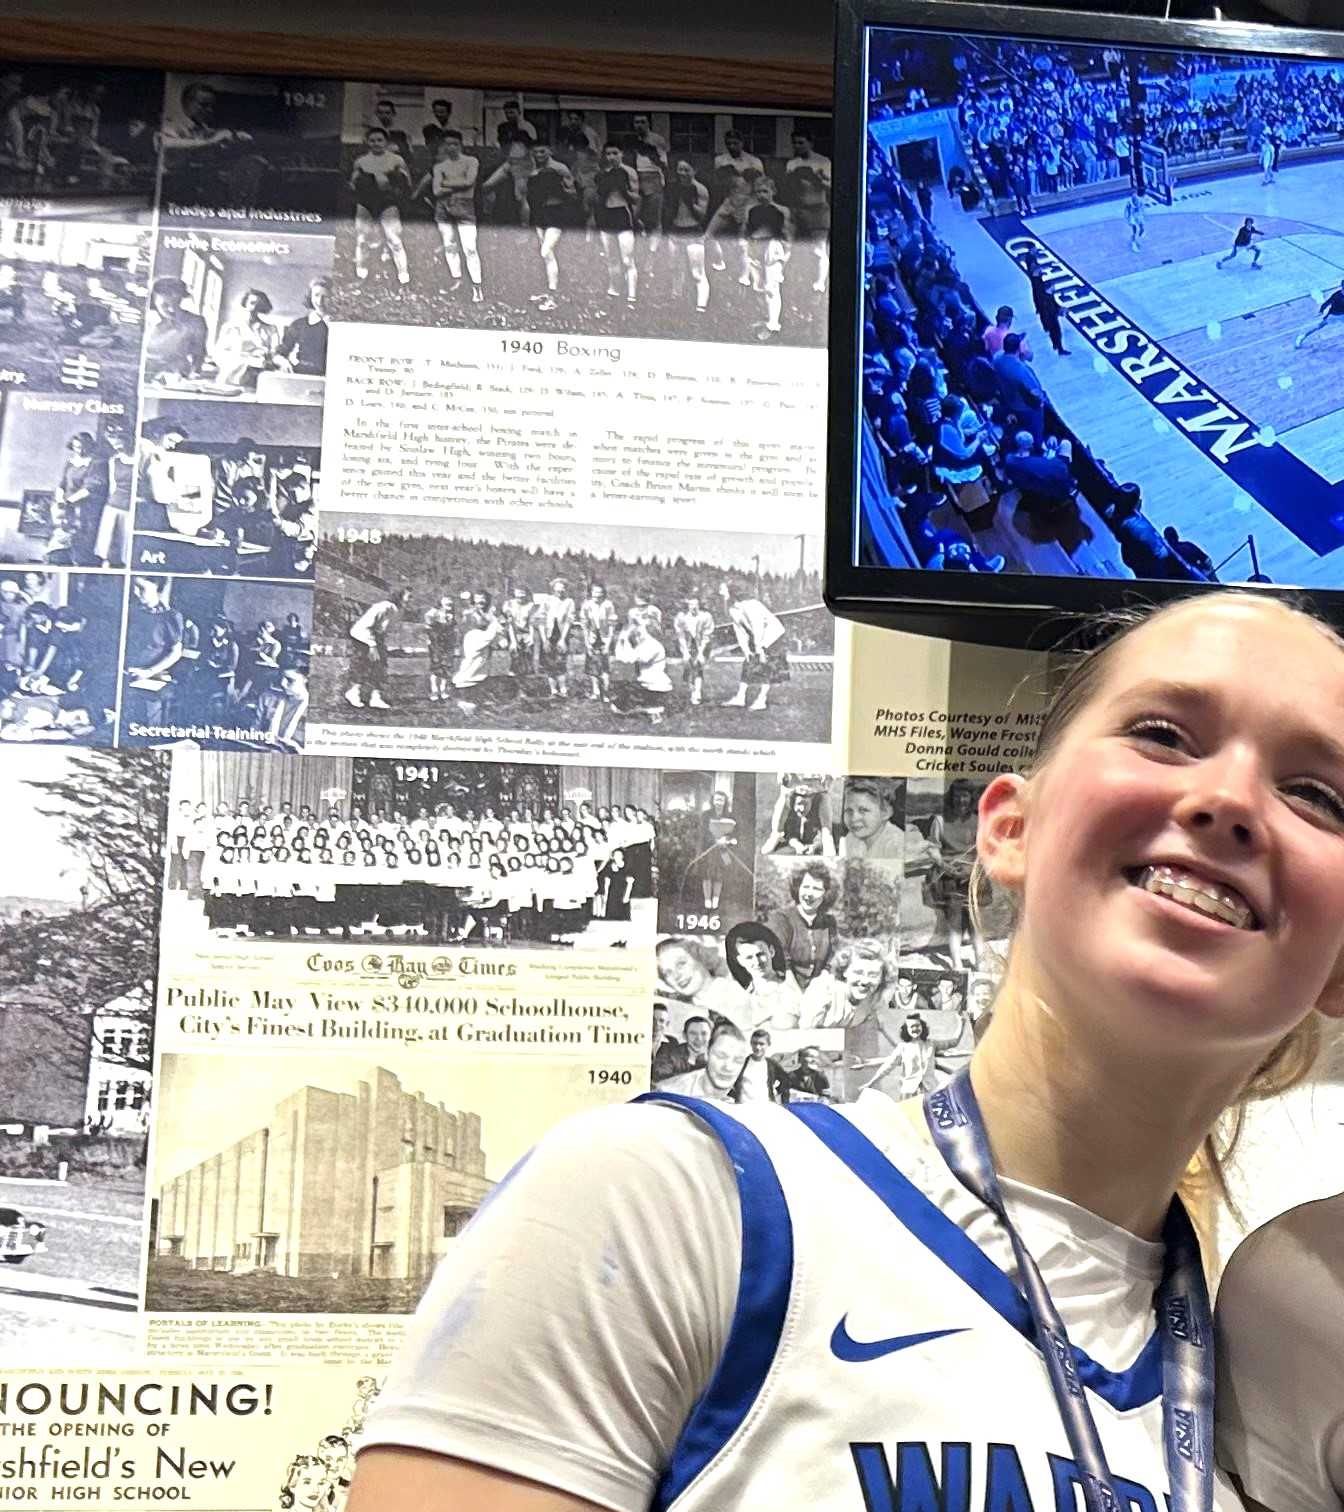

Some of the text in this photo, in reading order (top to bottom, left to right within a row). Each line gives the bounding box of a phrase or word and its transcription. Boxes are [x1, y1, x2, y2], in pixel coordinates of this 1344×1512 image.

[164, 234, 291, 255] Home Economics
[501, 340, 621, 362] 1940 Boxing
[23, 396, 125, 415] Nursery Class
[336, 527, 383, 545] 1948
[140, 549, 167, 565] Art
[875, 708, 1011, 727] Photos Courtesy of
[128, 722, 274, 745] Secretarial Training
[874, 725, 1037, 743] MHS Files, Wayne Frost
[904, 742, 999, 757] Donna Gould
[395, 765, 439, 783] 1941
[915, 759, 1014, 774] Cricket Soules
[676, 913, 722, 931] 1946
[457, 956, 518, 977] Times
[167, 987, 240, 1008] Public
[252, 990, 297, 1017] May
[309, 992, 362, 1012] View
[484, 997, 630, 1021] Schoolhouse,
[179, 1015, 241, 1041] City's
[246, 1016, 314, 1037] Finest
[427, 1026, 449, 1042] at
[456, 1023, 582, 1044] Graduation
[586, 1025, 646, 1045] Time
[587, 1070, 633, 1086] 1940
[0, 1382, 274, 1416] OUNCING!
[0, 1422, 171, 1437] THE OPENING OF
[0, 1443, 237, 1480] shfield's New
[0, 1486, 192, 1501] IOR HIGH SCHOOL
